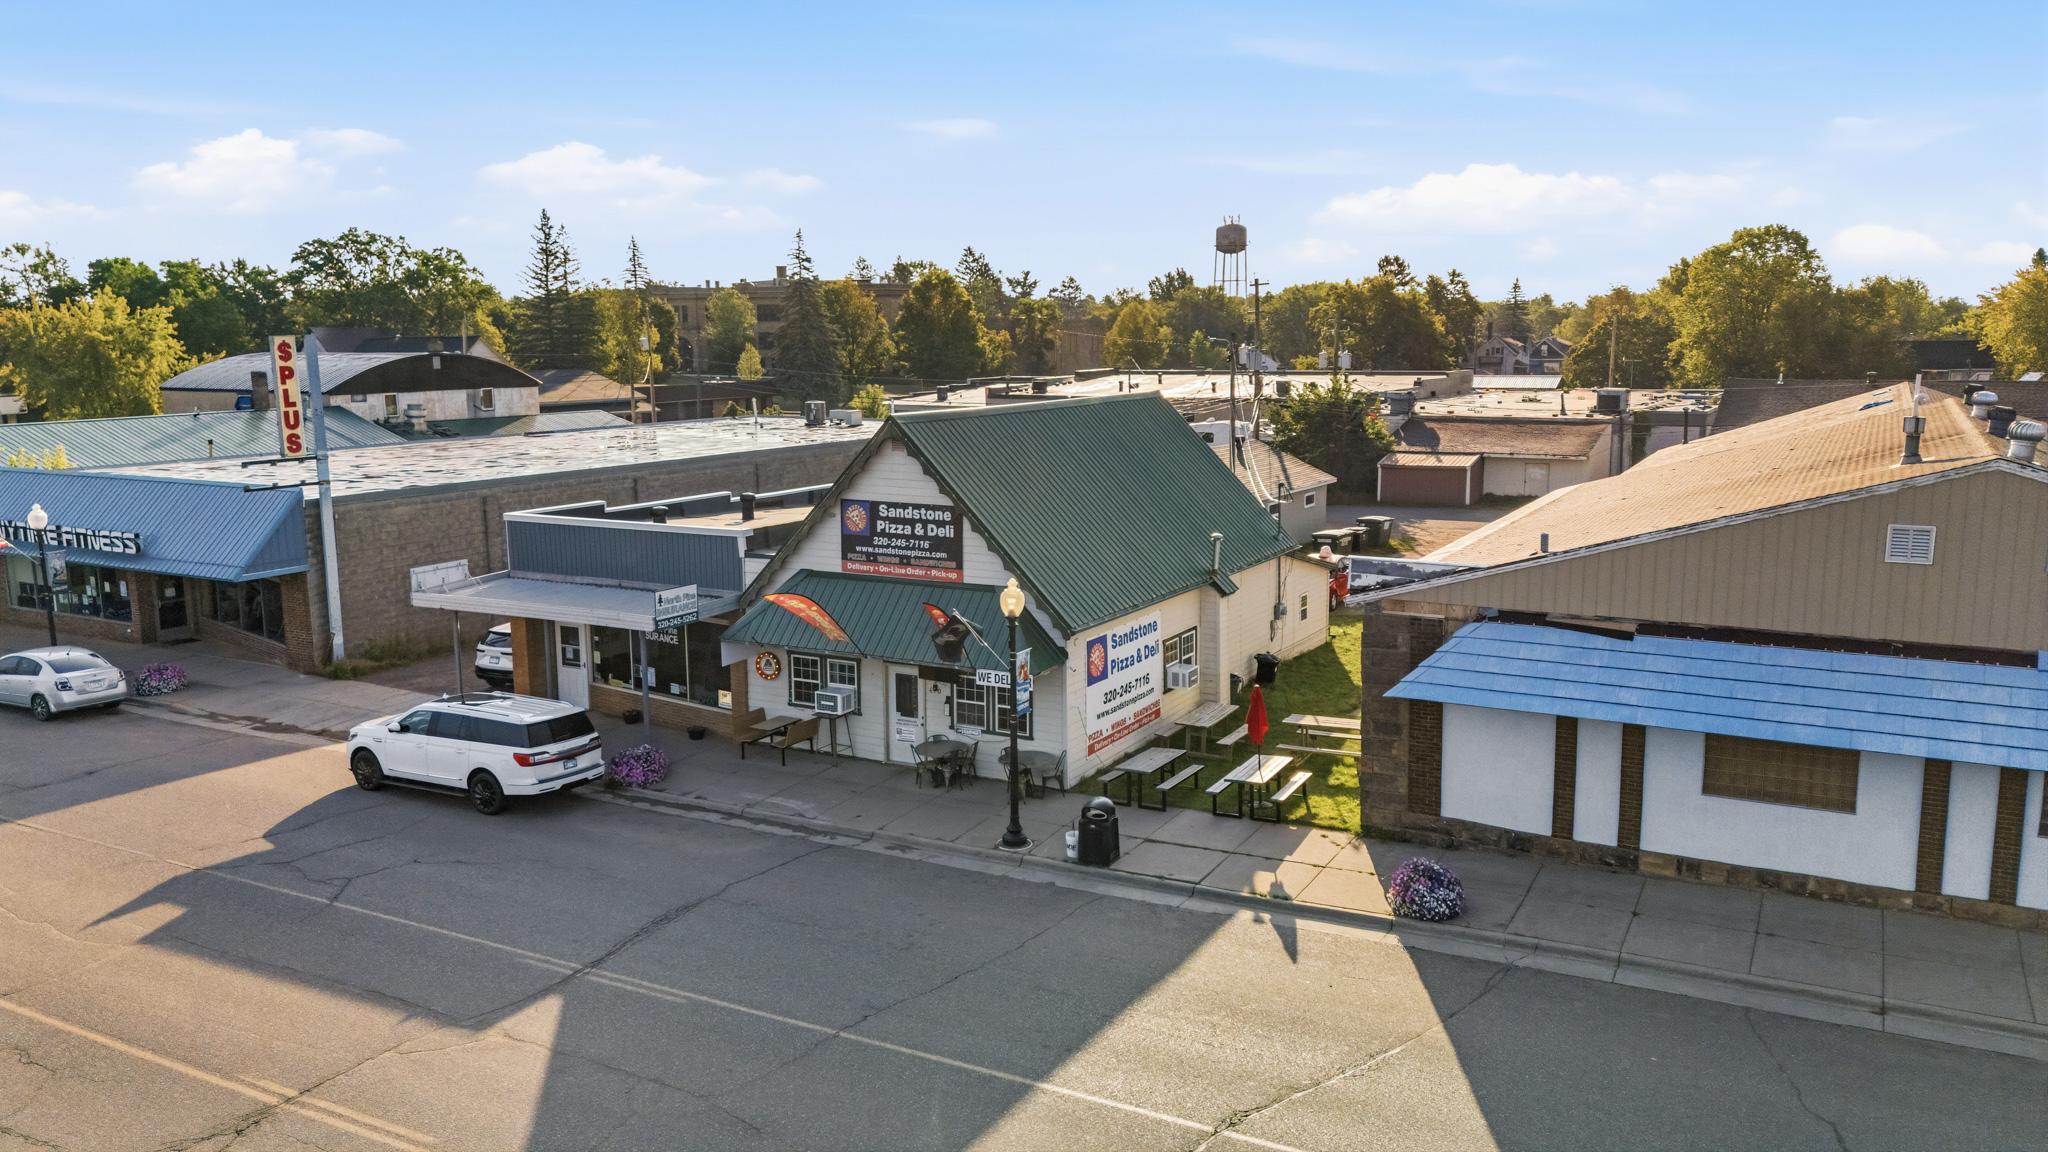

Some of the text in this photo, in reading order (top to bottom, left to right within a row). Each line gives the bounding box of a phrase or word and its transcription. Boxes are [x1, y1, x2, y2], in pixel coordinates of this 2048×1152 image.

[879, 504, 952, 521] Sandstone
[876, 520, 954, 538] Pizza & Deli
[61, 526, 137, 554] FITNESS
[873, 536, 930, 549] 320-245-7116
[855, 544, 948, 559] www.sandstonepizza.com
[847, 562, 874, 573] Delivery
[906, 567, 926, 576] Order
[657, 612, 697, 629] 320-245-5262
[1111, 620, 1158, 650] Sandstone
[1110, 657, 1135, 675] Pizza
[1136, 647, 1143, 664] &
[1144, 639, 1160, 660] Deli
[978, 671, 992, 683] WE
[1103, 673, 1150, 705] 320-245-7116
